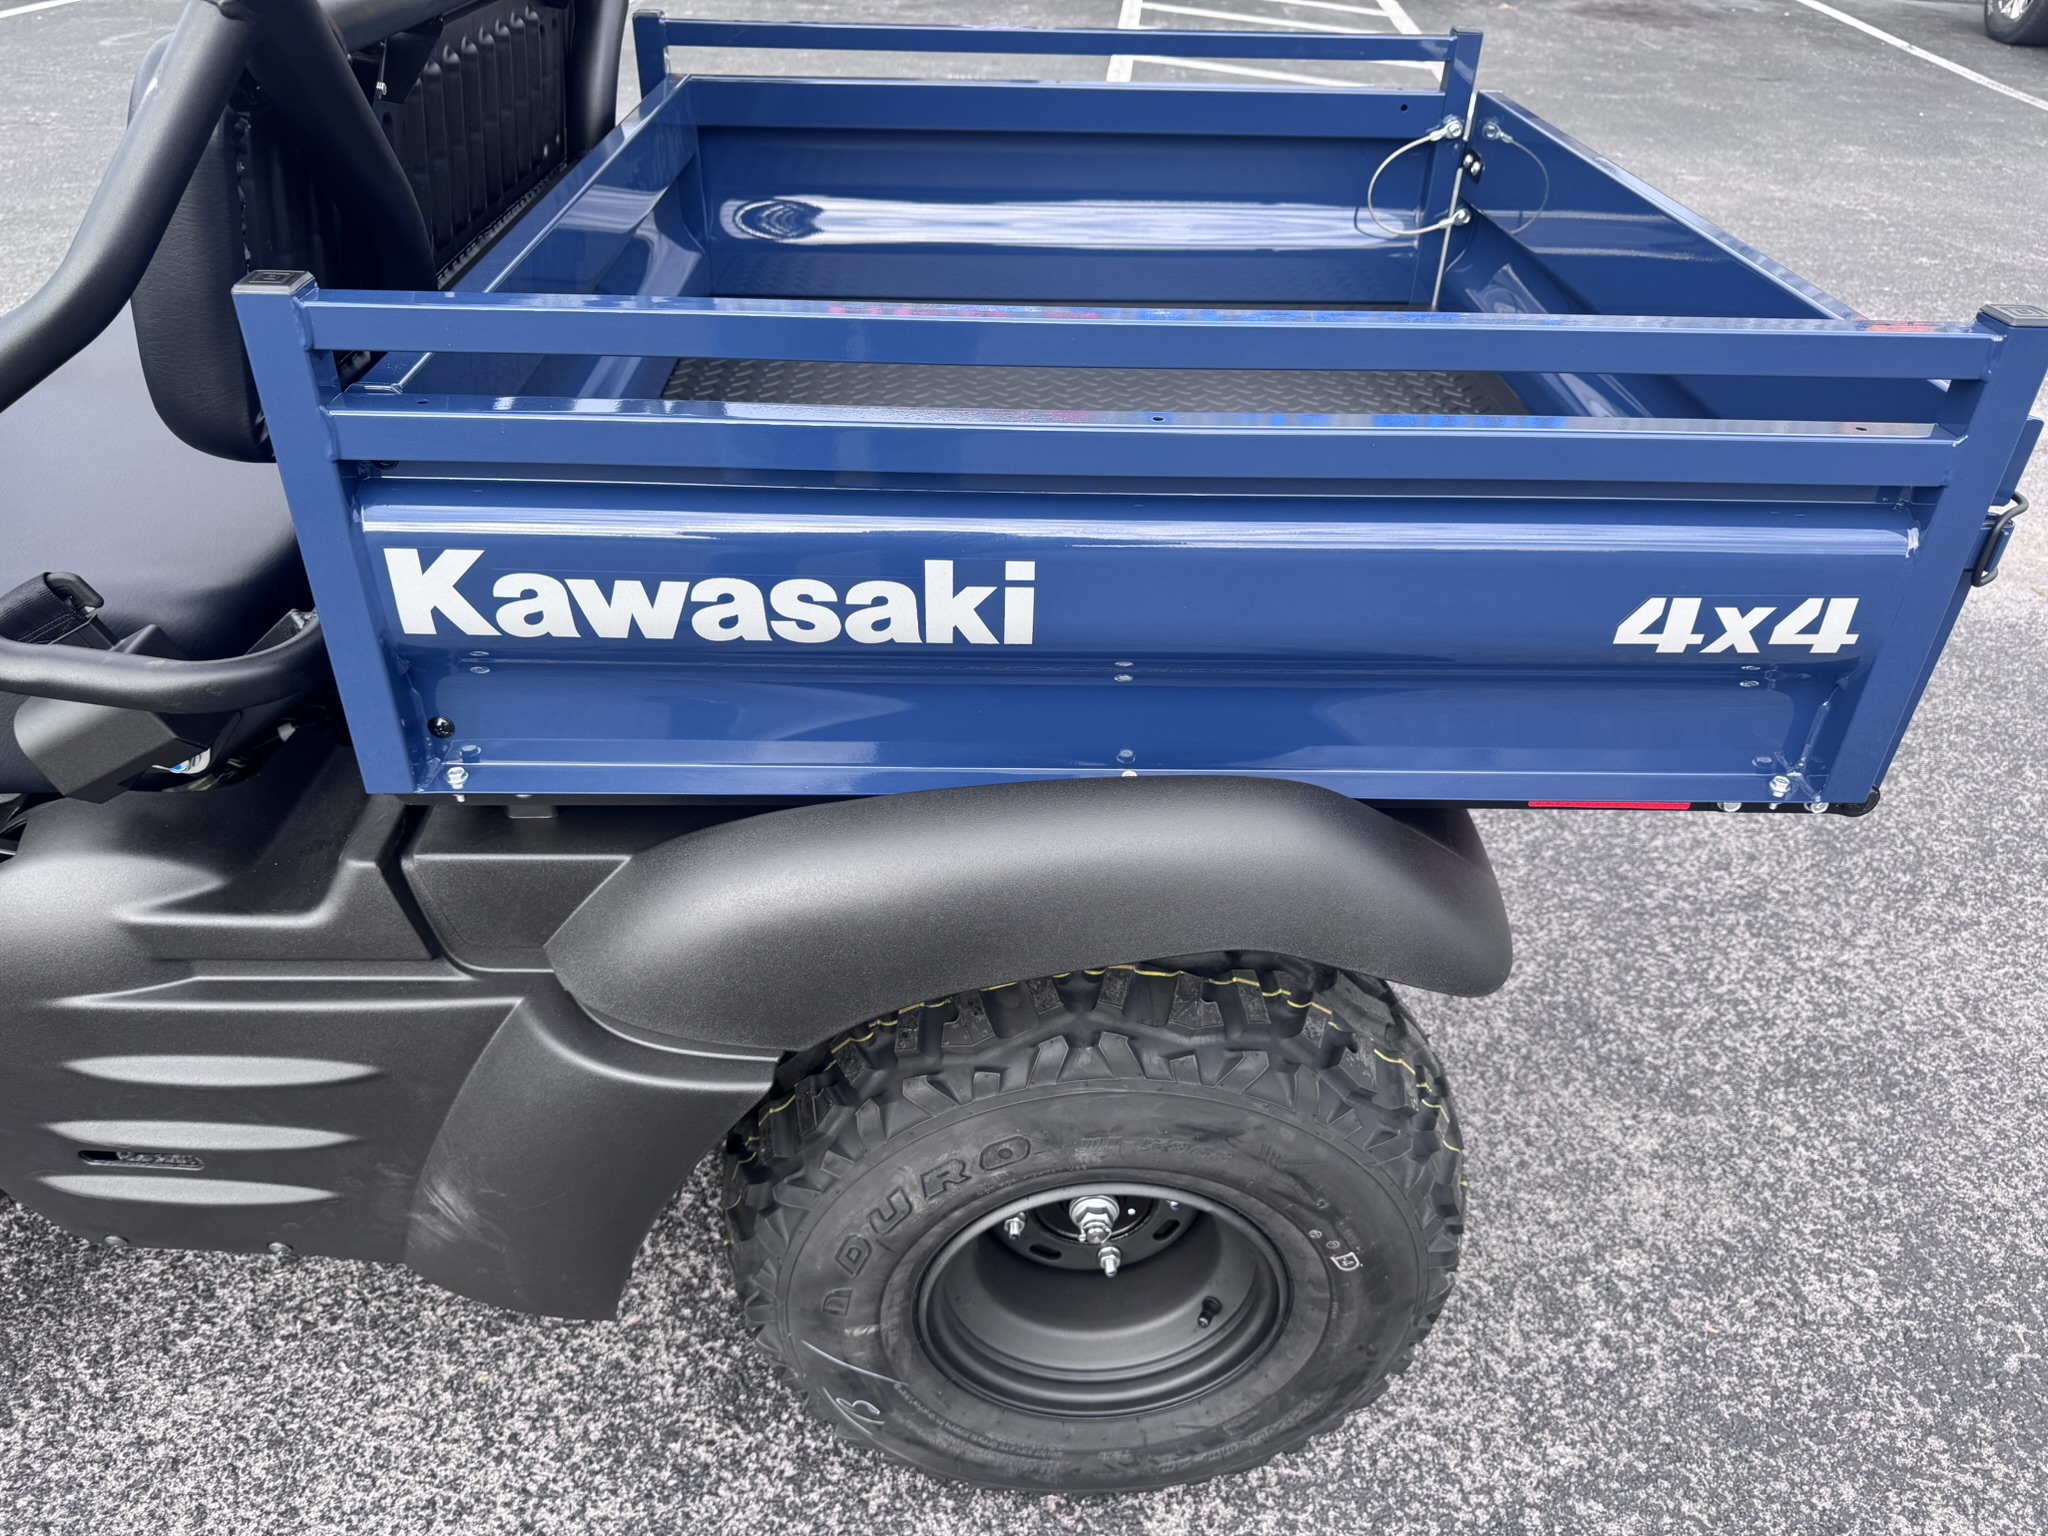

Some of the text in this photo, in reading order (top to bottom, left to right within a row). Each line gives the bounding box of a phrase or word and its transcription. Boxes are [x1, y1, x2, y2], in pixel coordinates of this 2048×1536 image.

[383, 547, 1035, 645] Kawasaki
[1612, 597, 1861, 654] 4x4
[835, 1133, 1031, 1278] DURO
